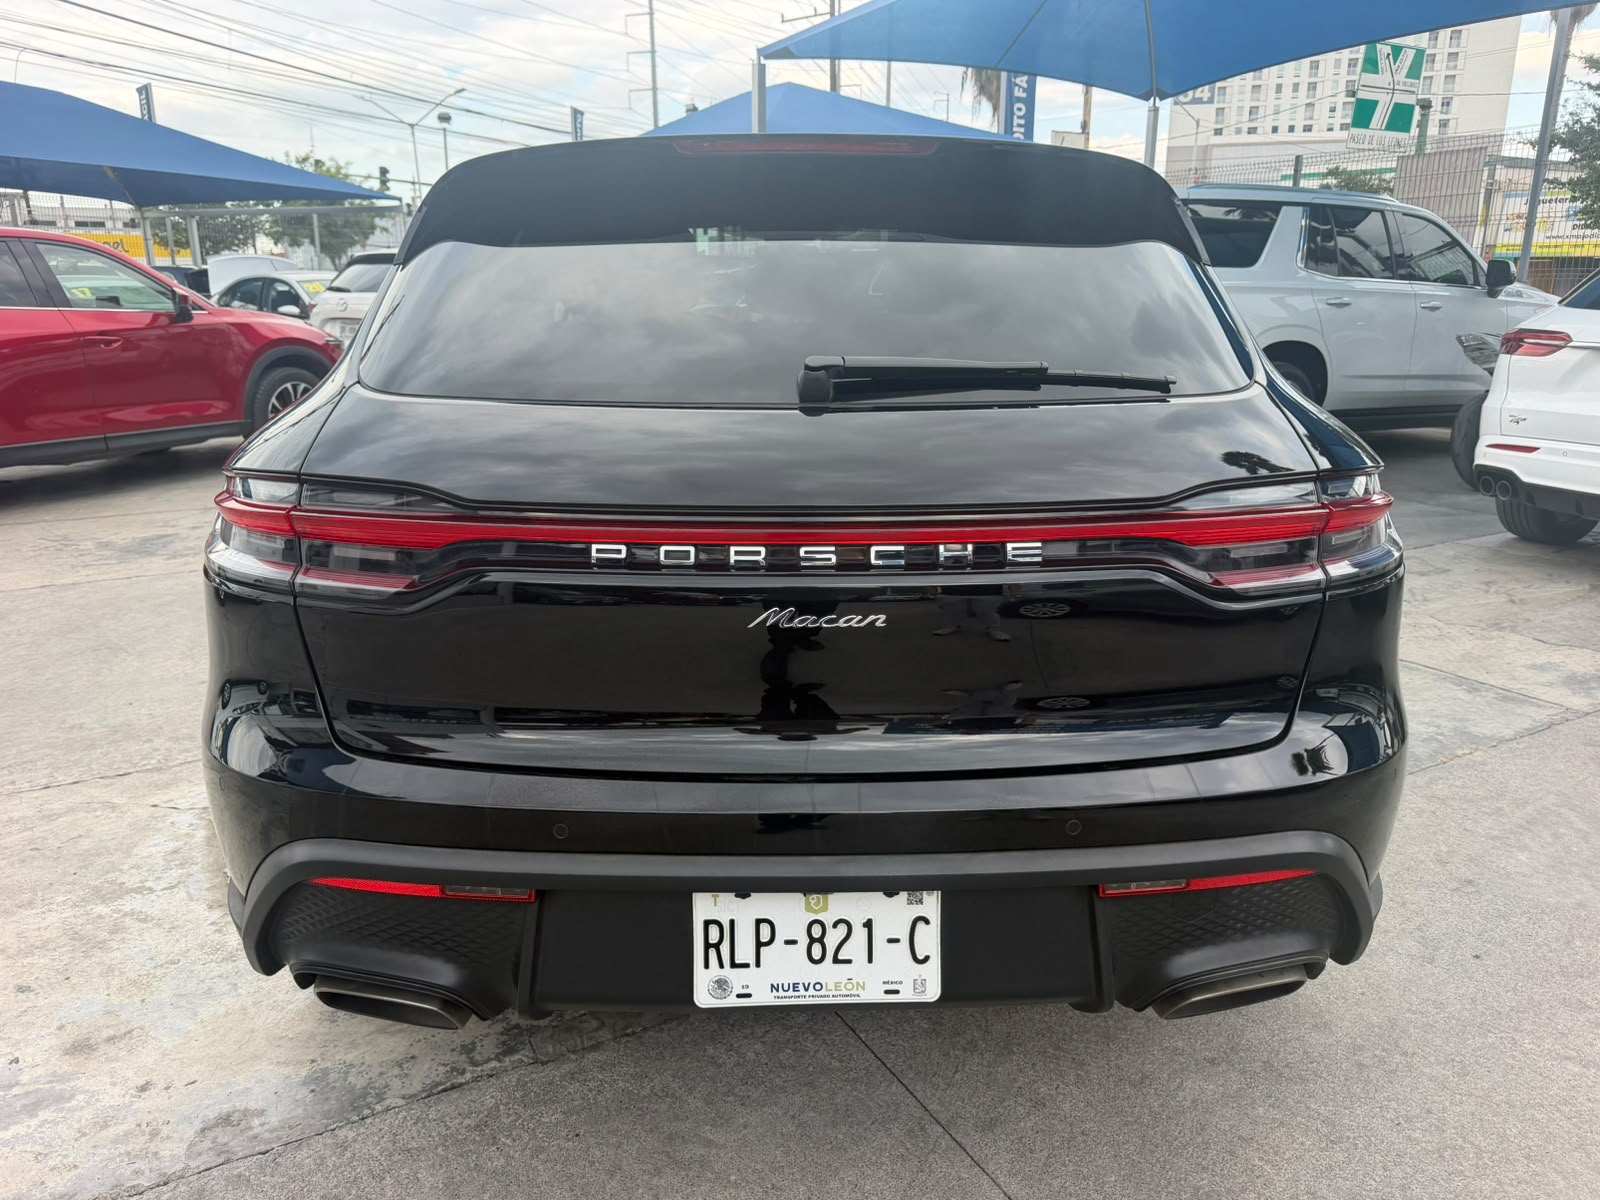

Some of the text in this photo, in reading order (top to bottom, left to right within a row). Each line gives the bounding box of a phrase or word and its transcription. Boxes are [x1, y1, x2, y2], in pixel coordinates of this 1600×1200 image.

[591, 542, 1042, 566] PORSCHE
[746, 607, 888, 628] Macan
[703, 915, 931, 970] RLP-821-C
